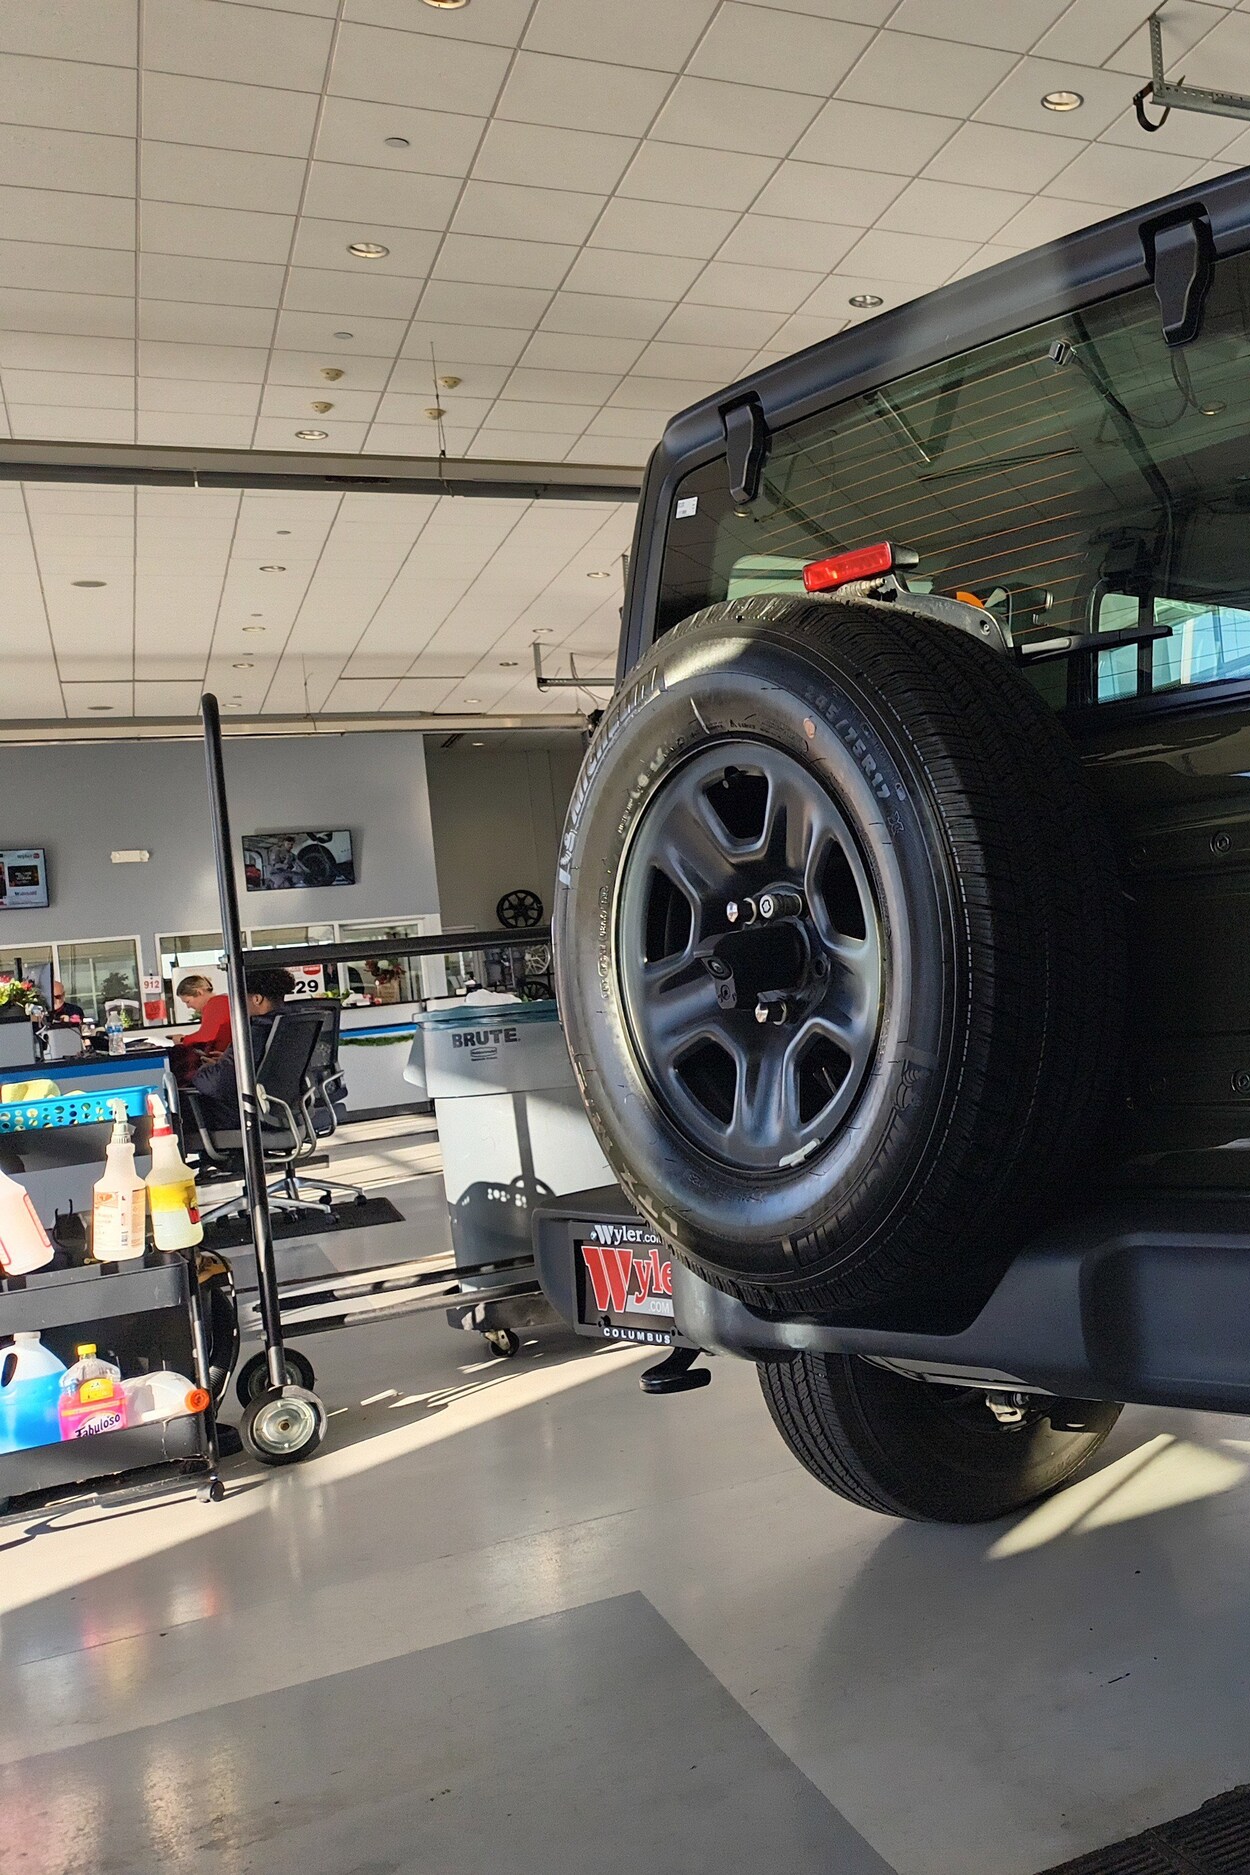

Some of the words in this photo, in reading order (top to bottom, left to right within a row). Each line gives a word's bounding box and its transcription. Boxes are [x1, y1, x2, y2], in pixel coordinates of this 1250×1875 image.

[143, 980, 160, 989] 912
[452, 1027, 518, 1048] BRUTE
[603, 1327, 671, 1344] COLUMBUS
[74, 1414, 121, 1438] Fabuloso
